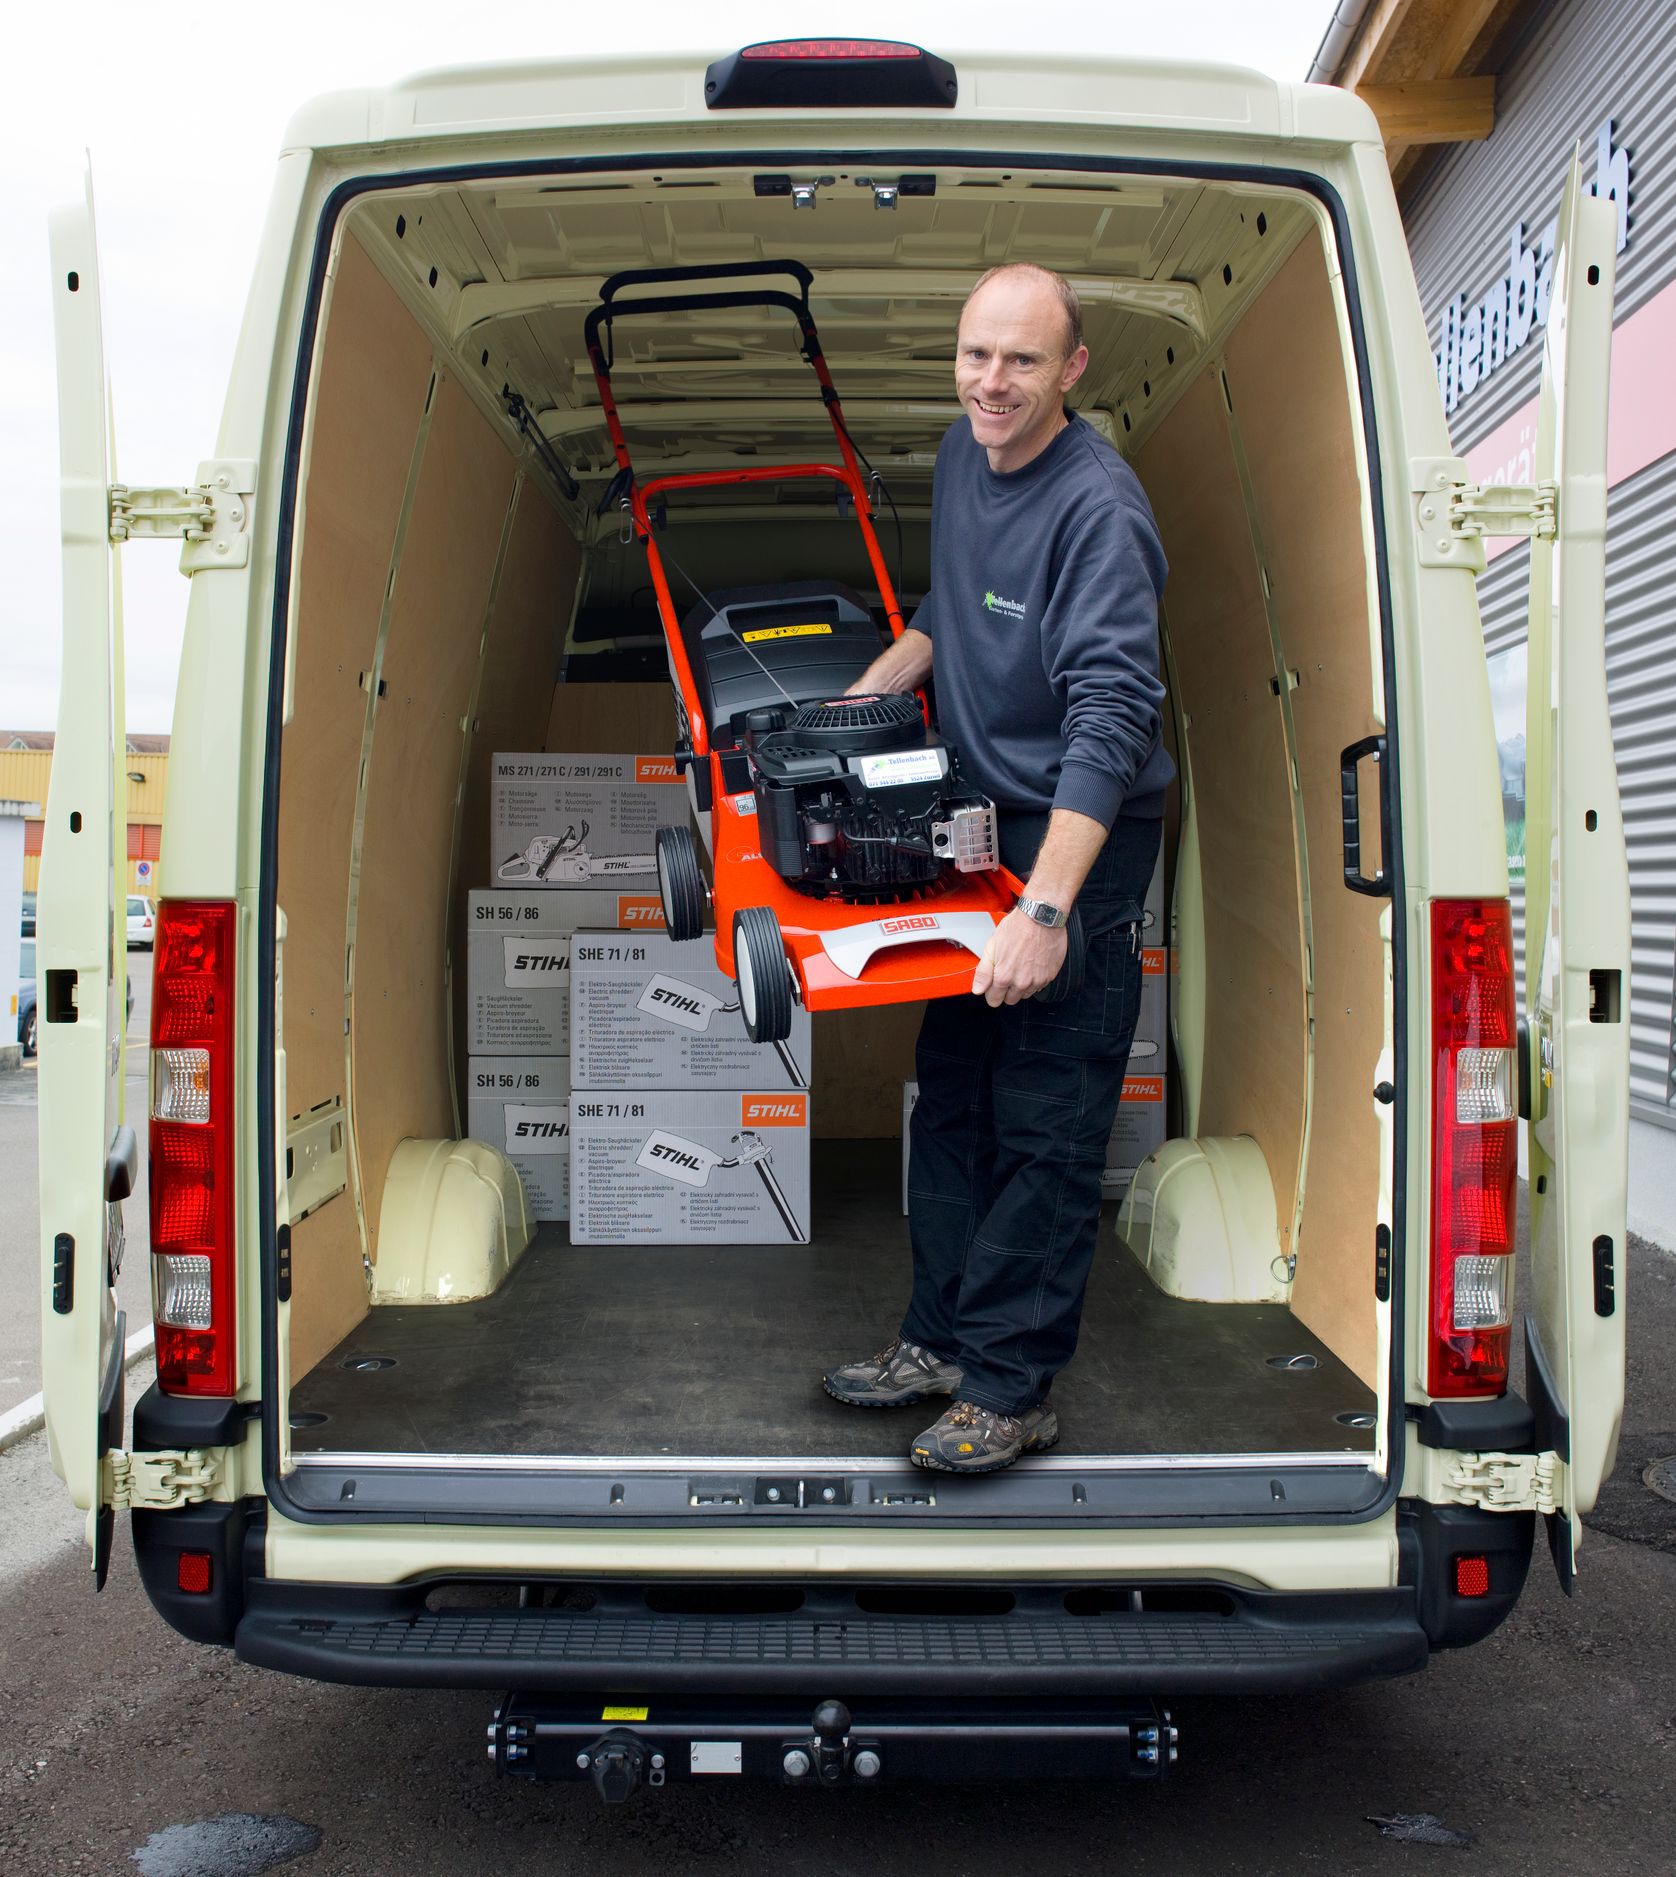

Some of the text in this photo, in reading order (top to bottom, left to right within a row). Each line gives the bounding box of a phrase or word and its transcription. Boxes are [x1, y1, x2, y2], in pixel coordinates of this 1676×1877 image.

[888, 754, 927, 764] Tellenbach
[499, 766, 515, 776] MS
[517, 766, 534, 776] 271
[541, 766, 557, 777] 271
[574, 767, 590, 777] 291
[597, 767, 613, 777] 291
[604, 862, 630, 870] STIHL
[476, 907, 495, 920] SH
[498, 907, 513, 919] 56
[524, 908, 539, 920] 86
[624, 907, 665, 920] STIH
[884, 916, 936, 932] SABO
[578, 948, 604, 960] SHE
[608, 948, 620, 960] 71
[632, 948, 645, 960] 81
[650, 988, 701, 1016] STIHL
[477, 1074, 495, 1087] SH
[498, 1074, 513, 1087] 56
[524, 1074, 540, 1087] 86
[578, 1104, 604, 1117] SHE
[607, 1105, 620, 1117] 71
[632, 1105, 645, 1117] 81
[746, 1104, 800, 1117] STIHL
[650, 1144, 700, 1170] STIHL
